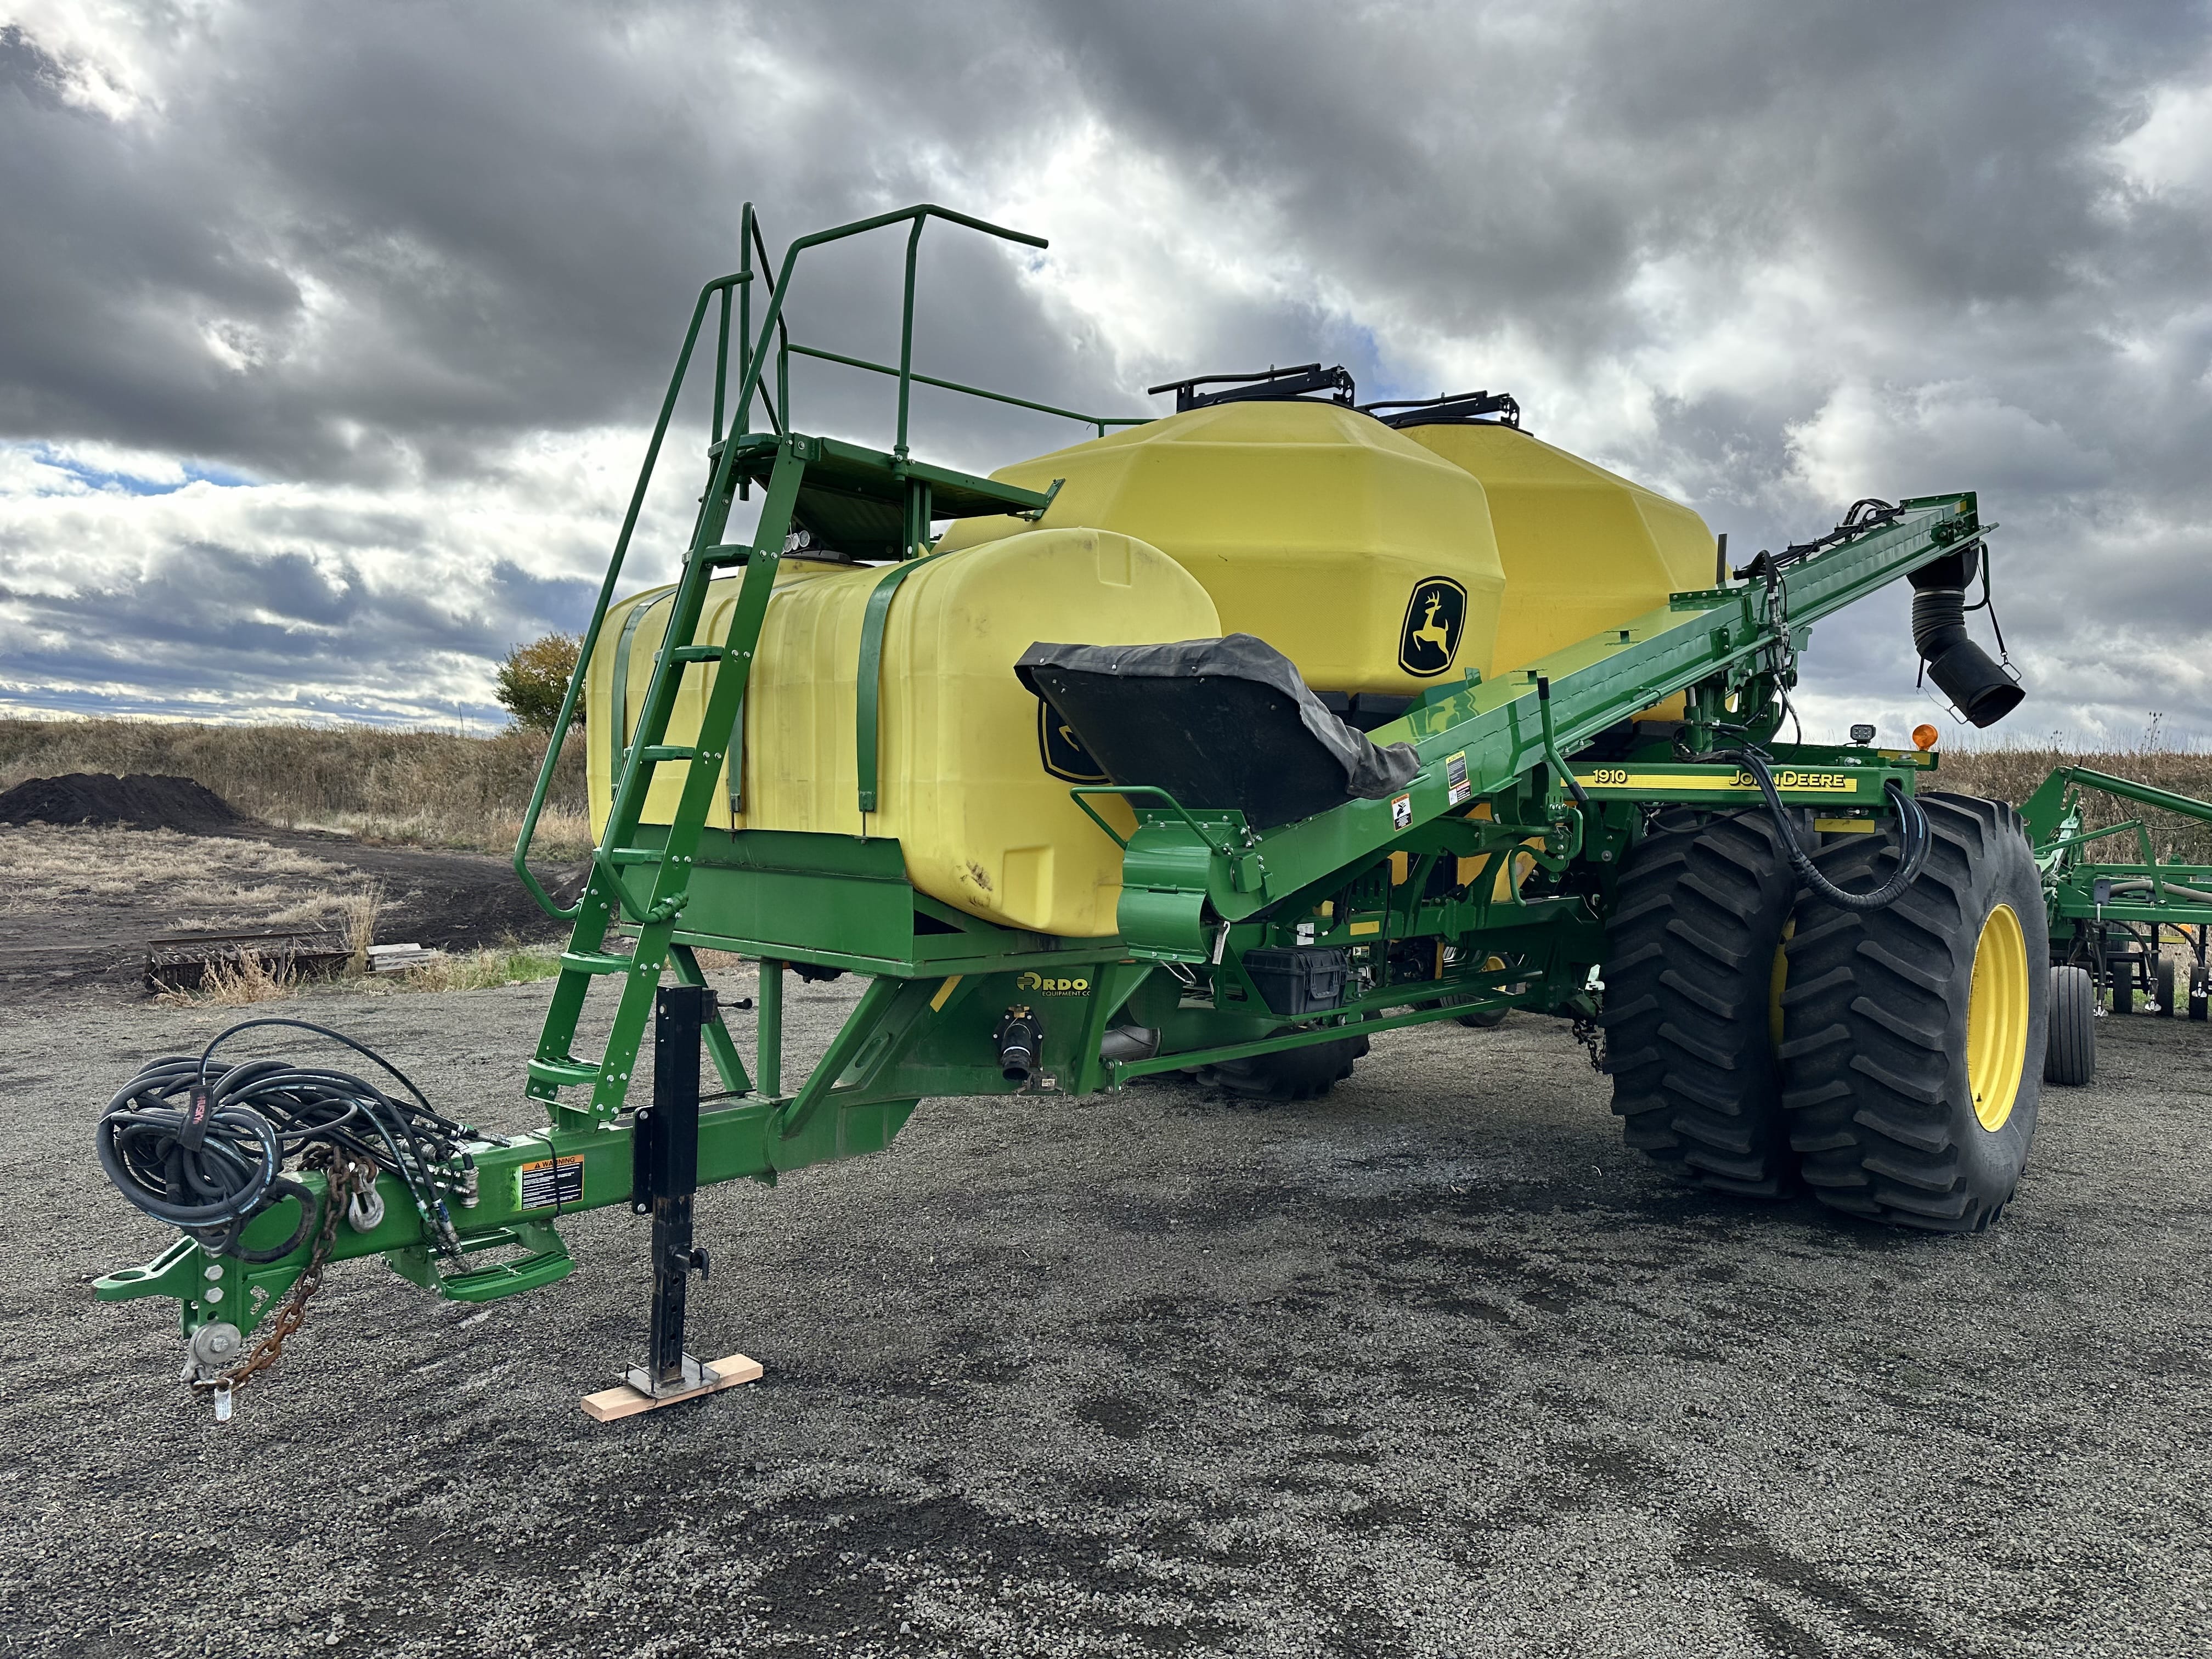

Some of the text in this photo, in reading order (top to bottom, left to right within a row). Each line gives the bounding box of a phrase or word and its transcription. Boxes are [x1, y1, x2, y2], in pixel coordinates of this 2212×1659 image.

[1593, 769, 1627, 783] 1910
[1729, 770, 1844, 787] JO DEERE
[193, 1094, 206, 1123] HUSKY
[542, 1156, 575, 1167] WANING
